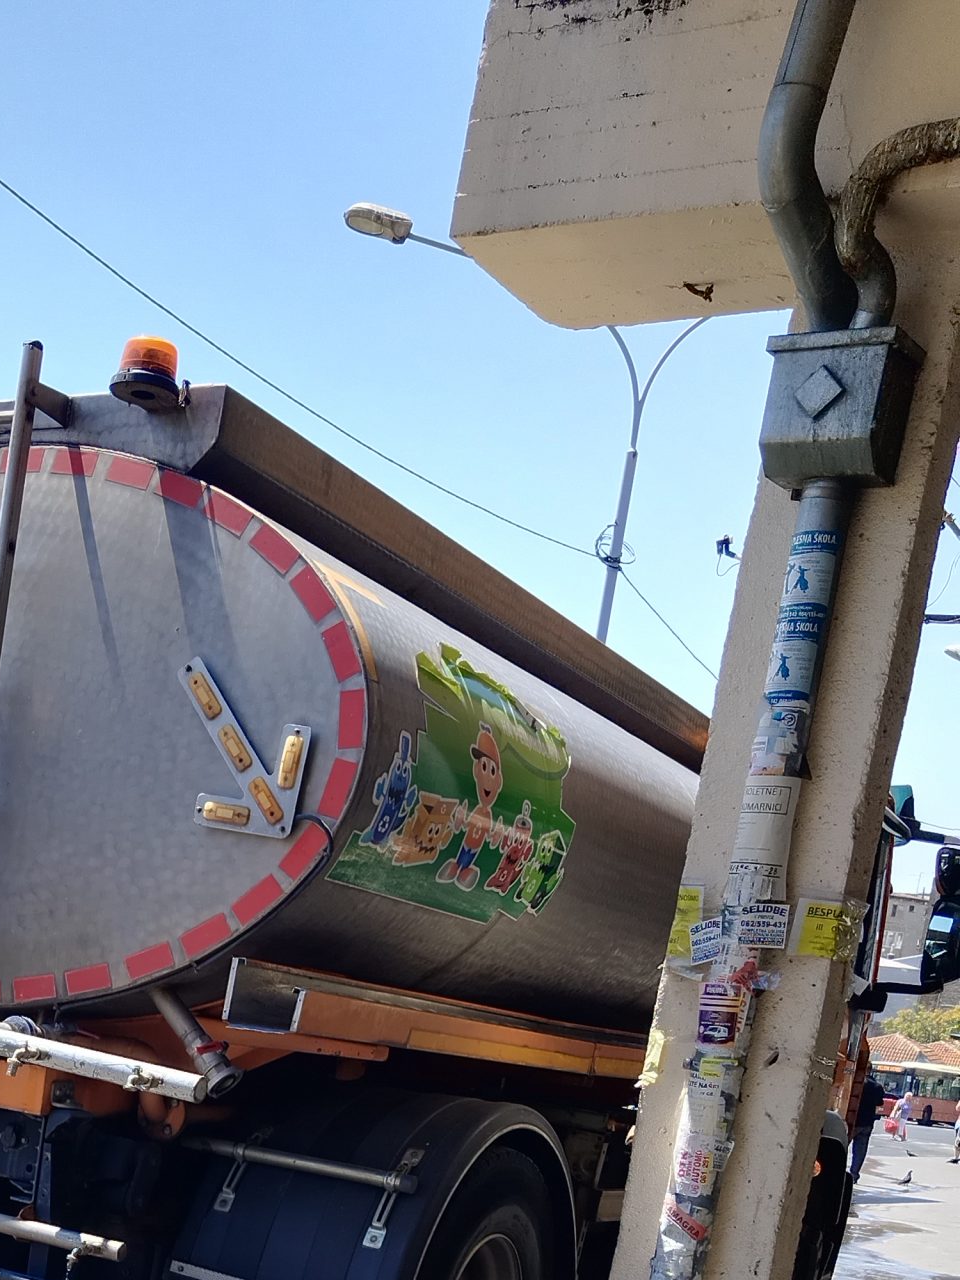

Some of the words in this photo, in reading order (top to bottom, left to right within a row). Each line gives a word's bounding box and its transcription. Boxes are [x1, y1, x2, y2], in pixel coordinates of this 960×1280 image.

[742, 904, 788, 918] SELIDBE
[807, 906, 844, 919] BESPLA
[690, 920, 721, 936] SELIDBE
